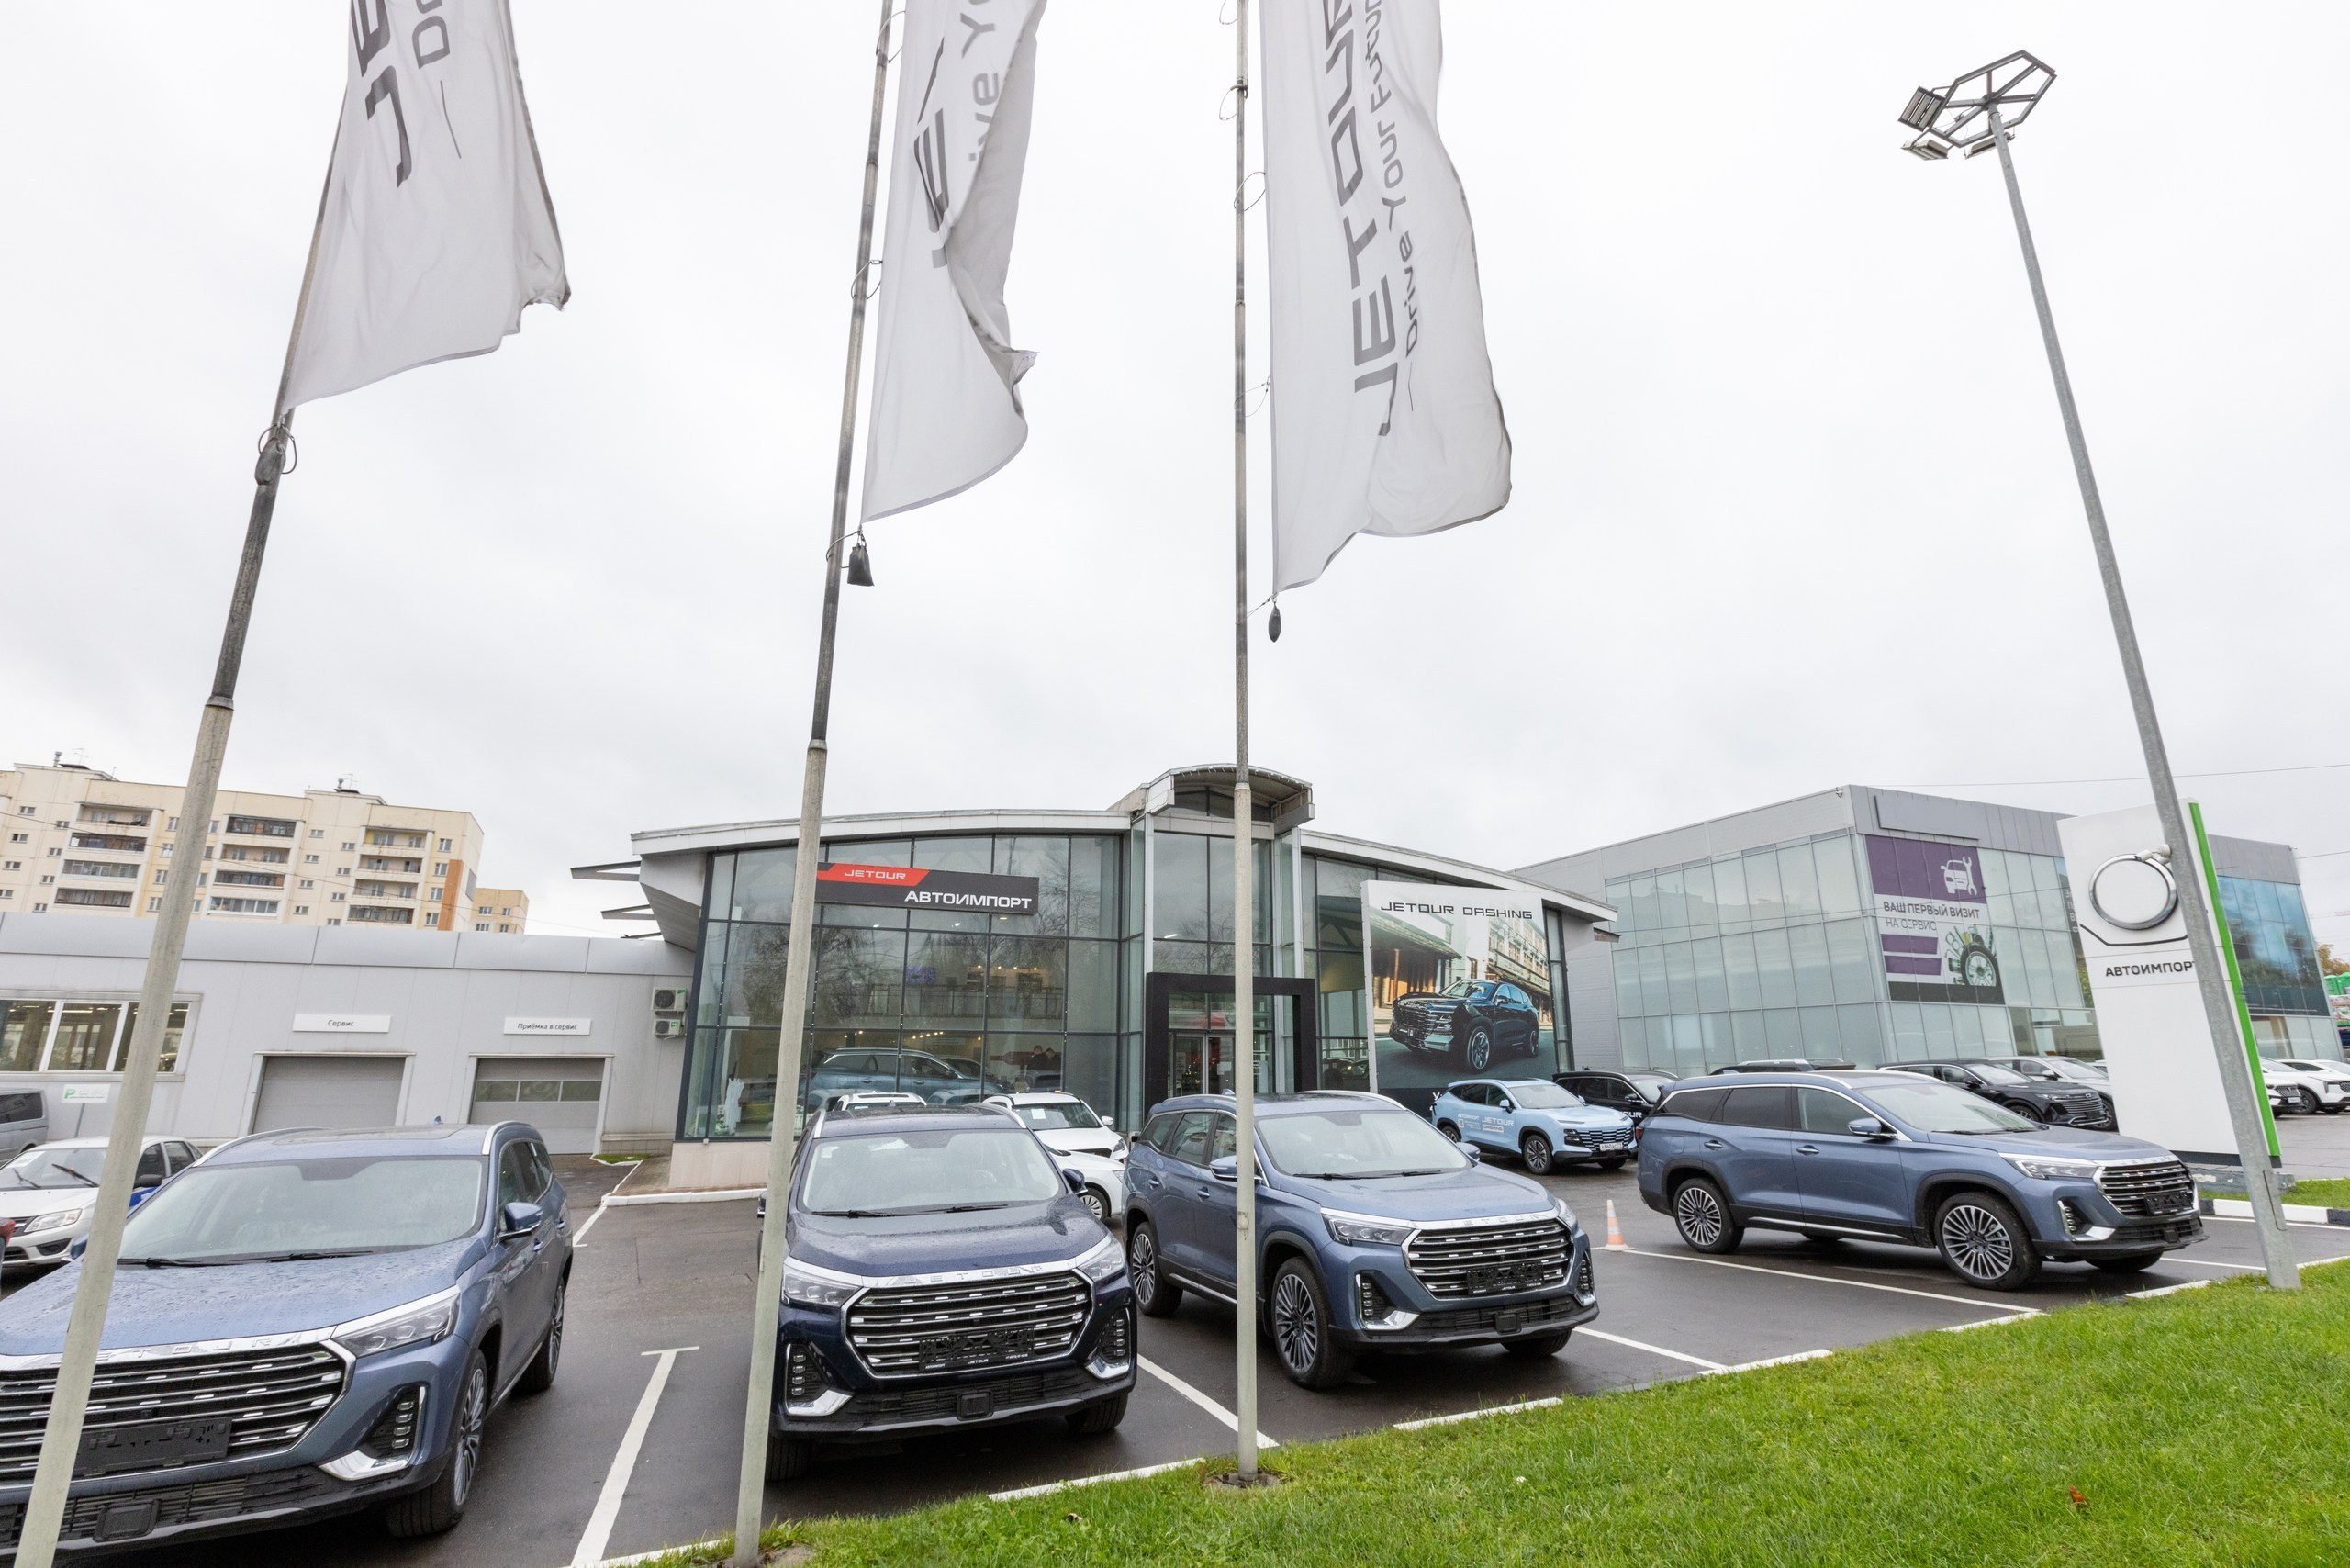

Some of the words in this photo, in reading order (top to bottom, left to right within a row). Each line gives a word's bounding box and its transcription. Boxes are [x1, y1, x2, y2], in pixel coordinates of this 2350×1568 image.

[1364, 0, 1393, 115] Futur
[1376, 119, 1407, 233] Your
[1399, 230, 1418, 359] Drive
[844, 868, 906, 881] JETOUR
[904, 890, 1032, 909] АВТОИМПОРТ
[1381, 902, 1455, 915] JETOUR
[1462, 906, 1533, 920] DASHING
[1883, 901, 1906, 913] ВАШ
[1908, 903, 1947, 916] ПЕРВЫЙ
[1950, 907, 1980, 919] ВИЗИТ
[1886, 918, 1898, 928] НА
[1900, 918, 1937, 931] СЕРВИС
[2105, 960, 2195, 977] АВТОИМПОР
[327, 1019, 354, 1028] Сервис
[517, 1023, 548, 1031] Приёмка
[1482, 1115, 1514, 1126] JETOUR
